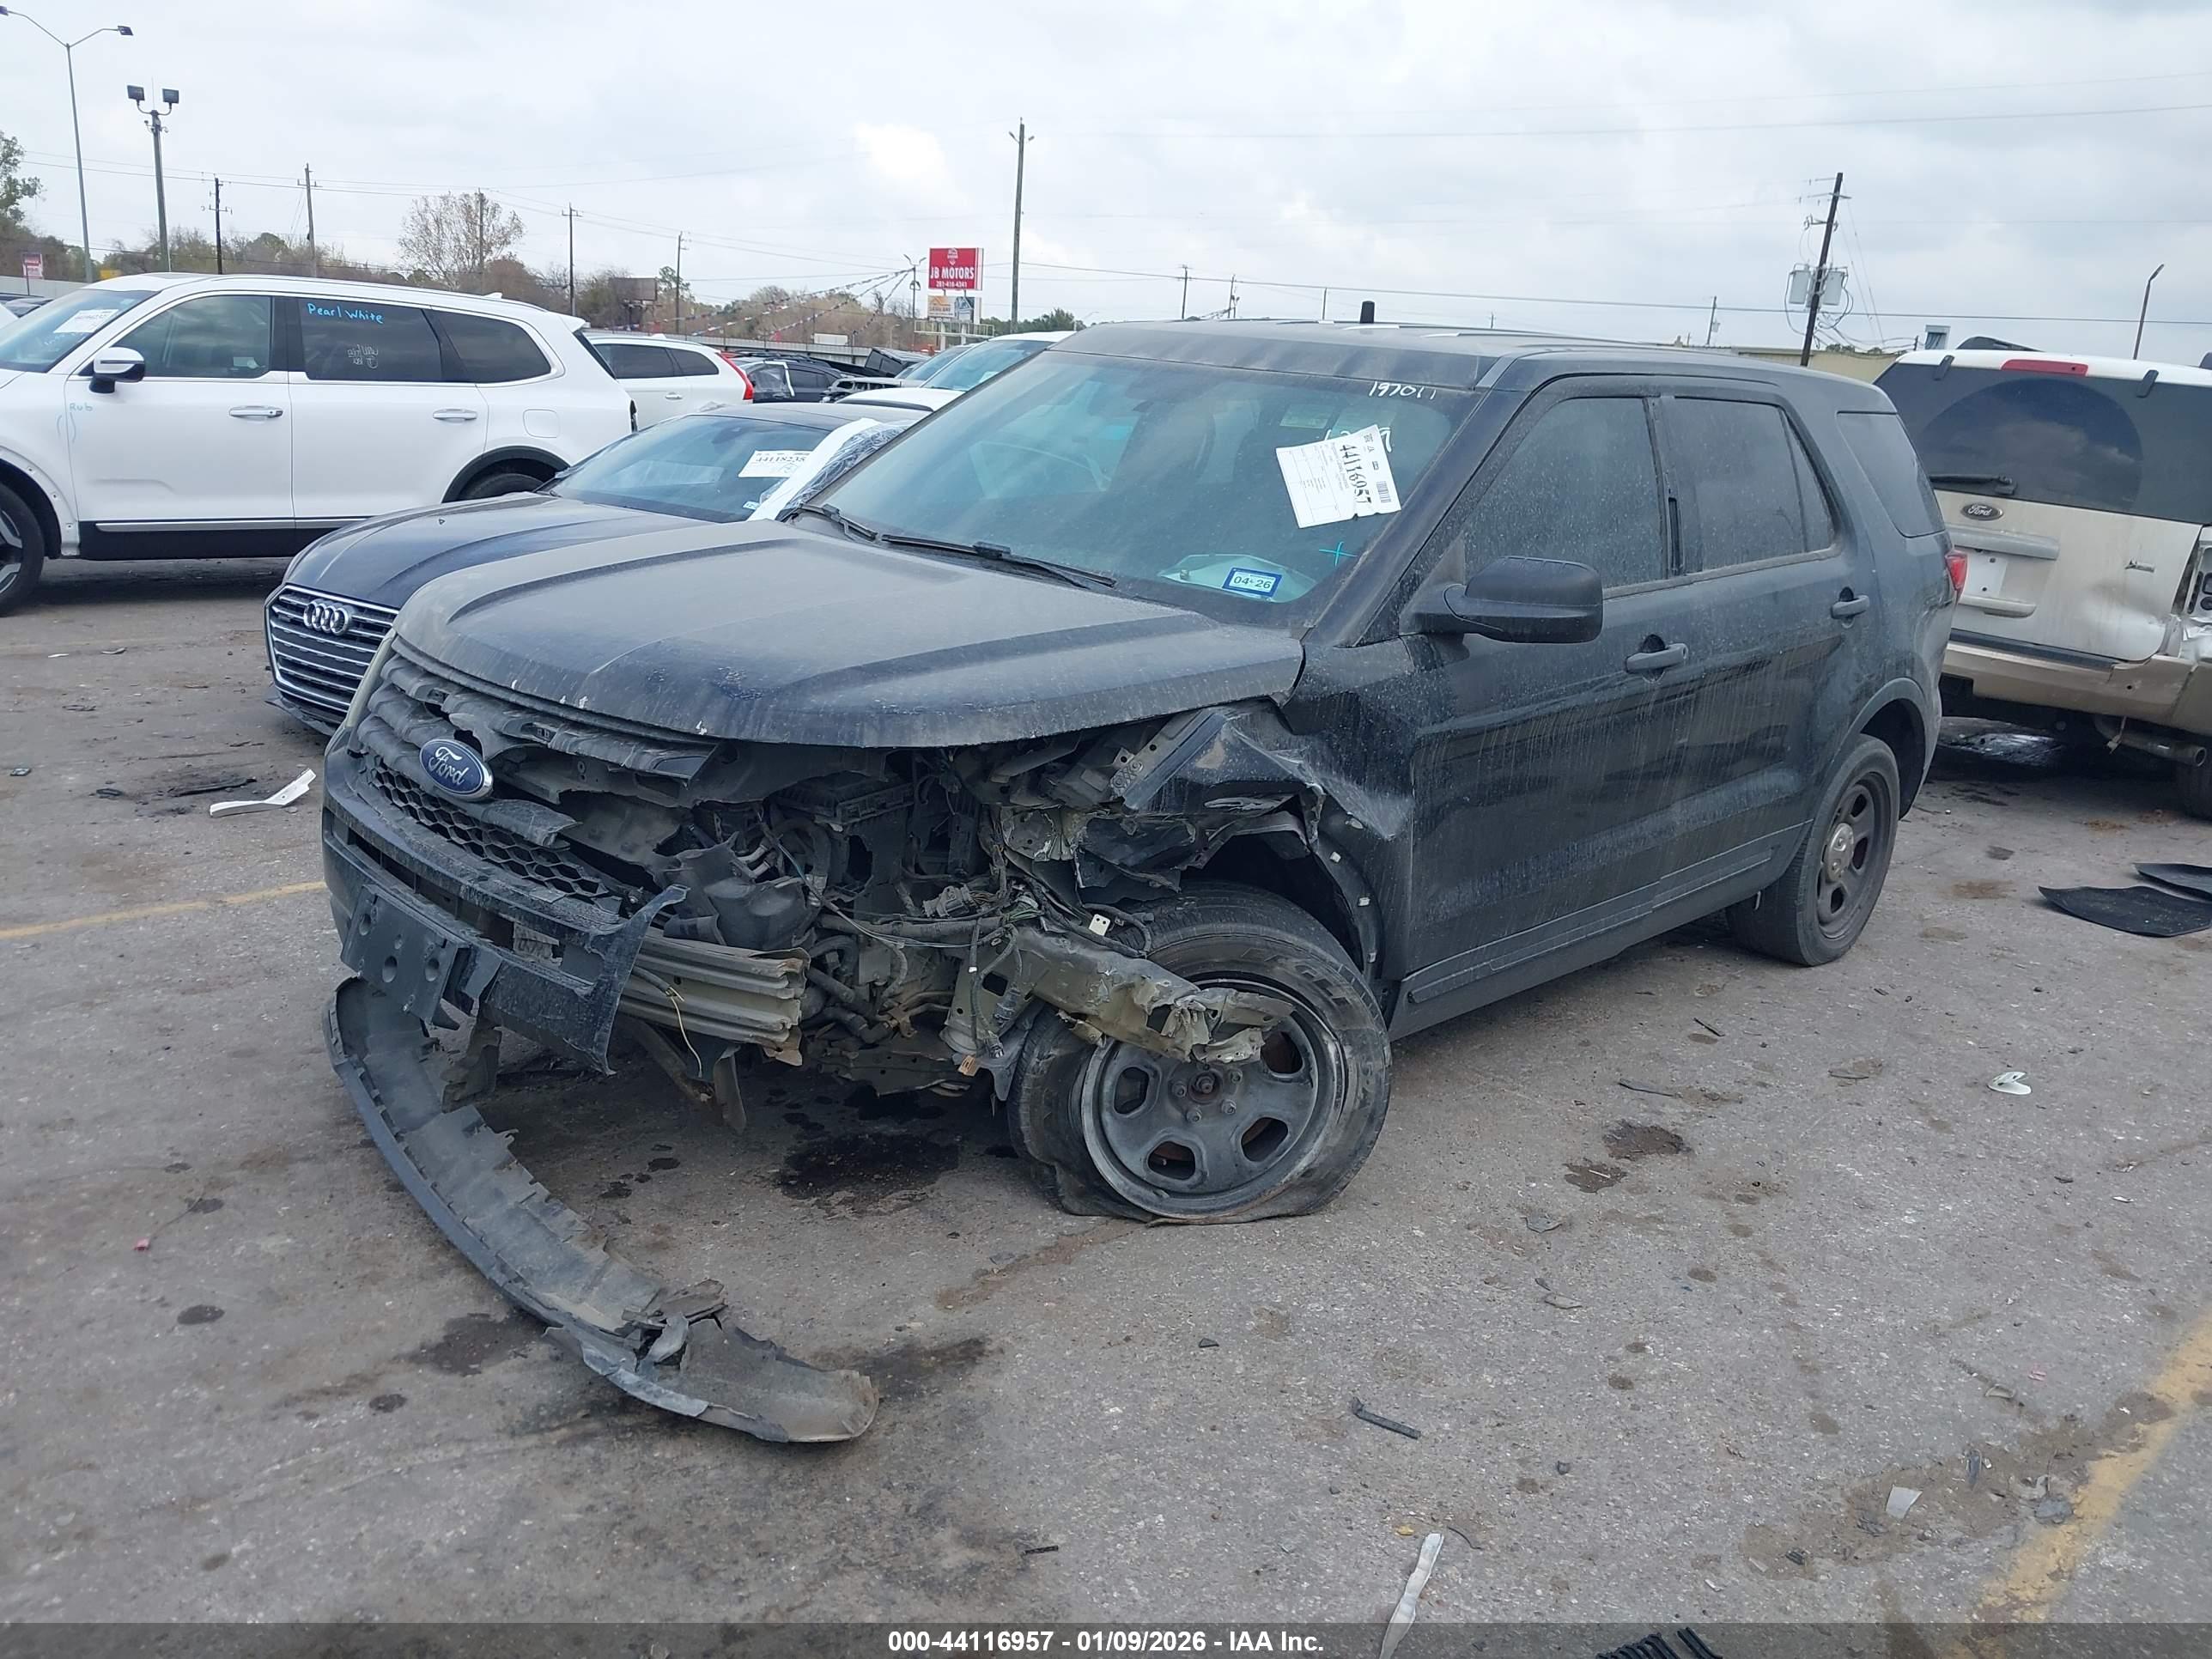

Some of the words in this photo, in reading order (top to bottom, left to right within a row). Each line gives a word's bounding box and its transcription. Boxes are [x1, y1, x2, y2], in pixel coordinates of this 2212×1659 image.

[930, 267, 939, 279] JB
[941, 267, 975, 279] MOTORS
[307, 303, 342, 318] Pearl
[344, 309, 384, 324] White
[69, 402, 93, 411] Rub
[1340, 445, 1372, 503] 44116957
[1967, 504, 1992, 516] Ford
[1233, 575, 1249, 585] 04
[1255, 579, 1272, 589] 26
[428, 746, 469, 785] Ford
